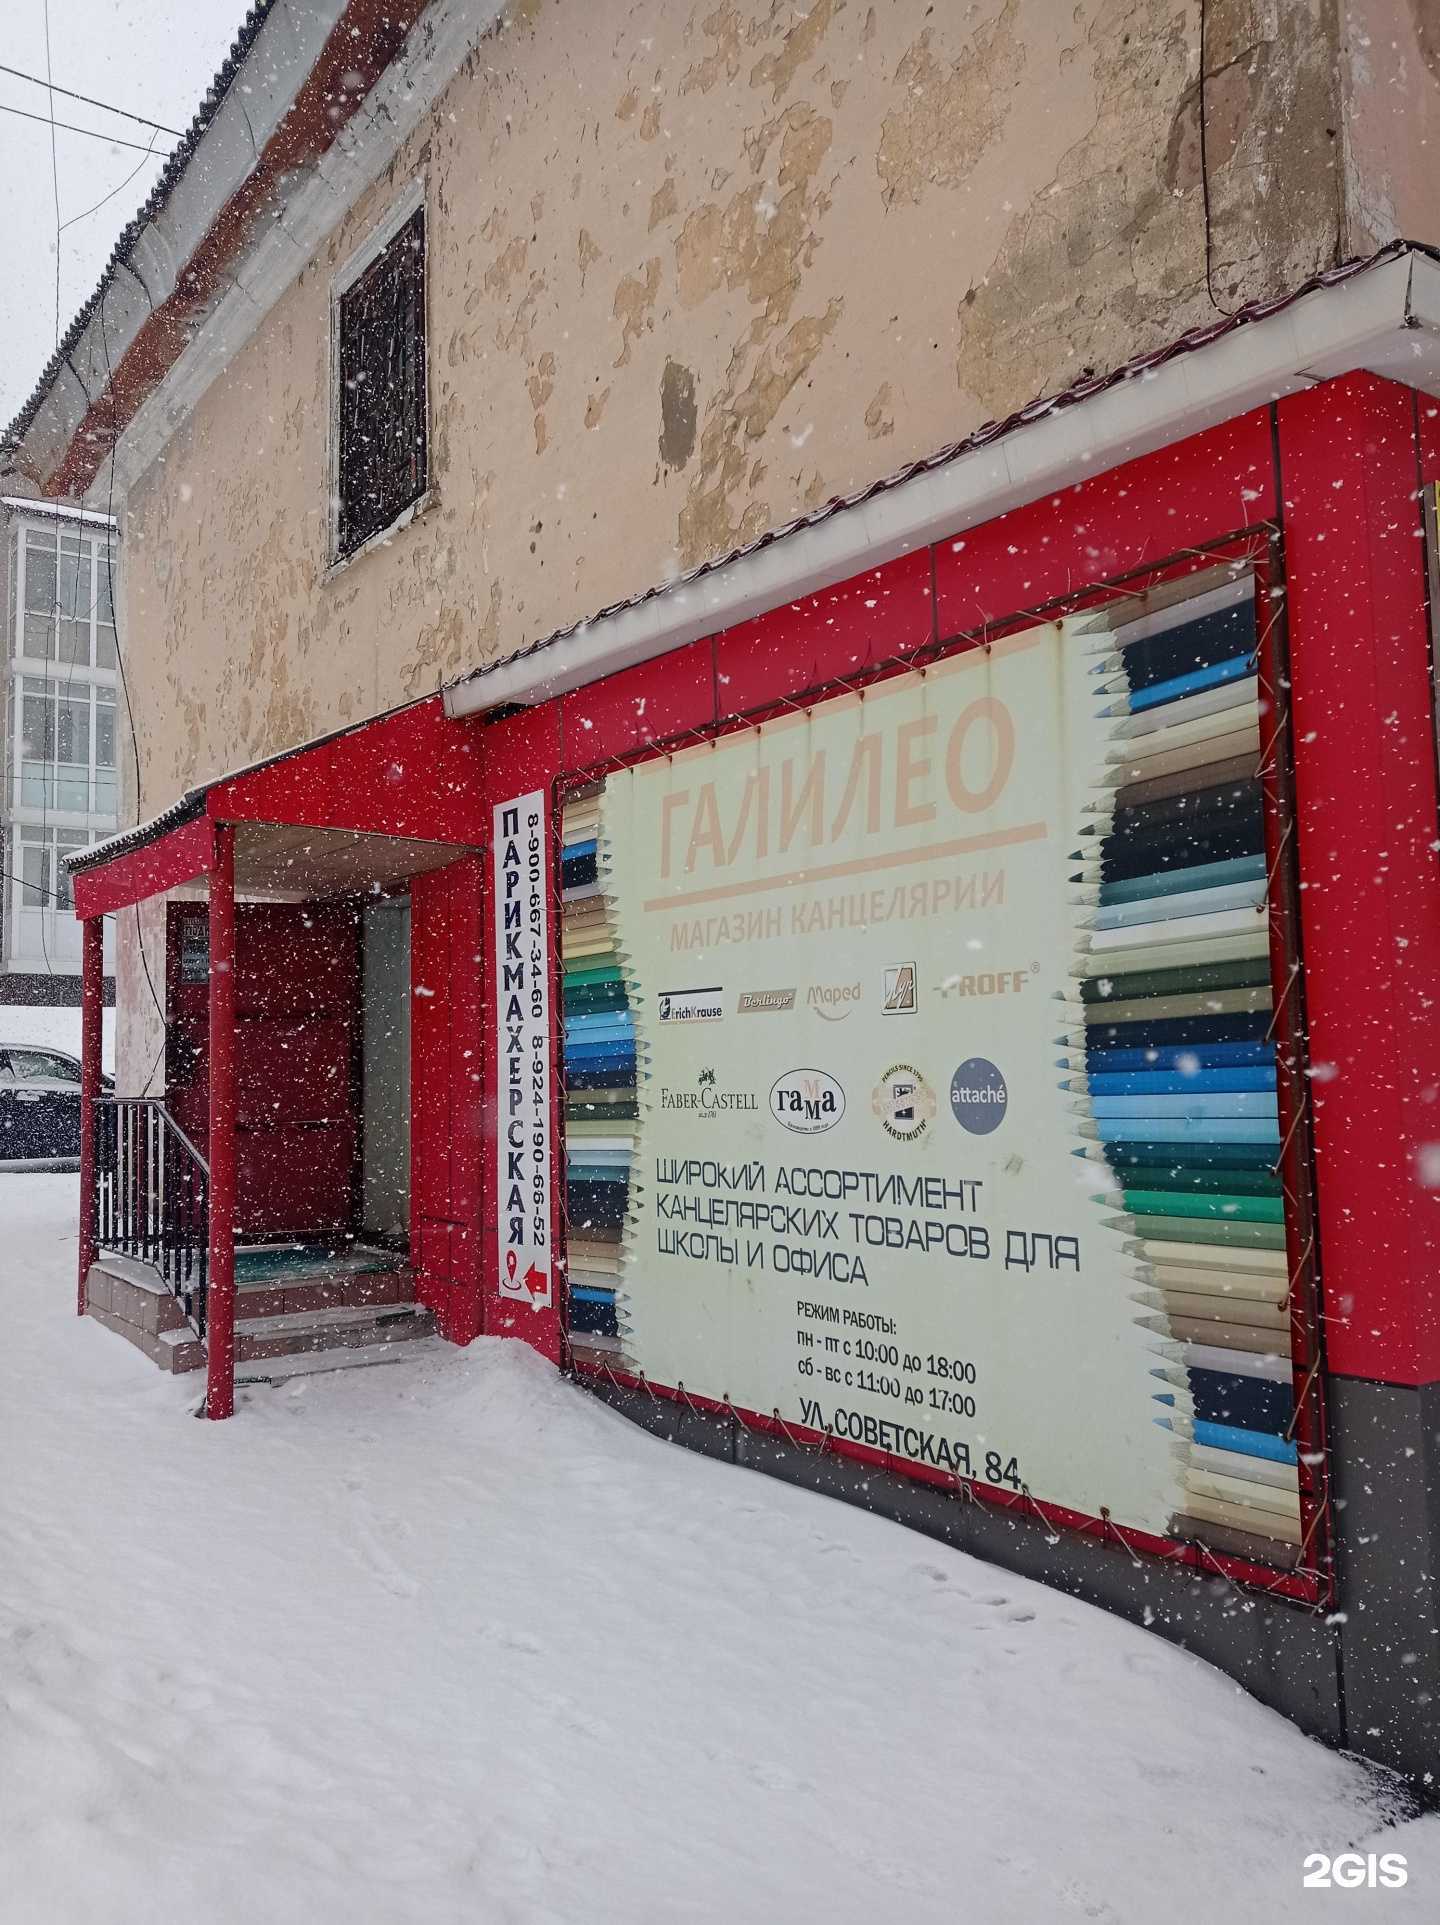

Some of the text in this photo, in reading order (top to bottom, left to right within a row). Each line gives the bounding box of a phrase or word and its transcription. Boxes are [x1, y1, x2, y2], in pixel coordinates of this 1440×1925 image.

[660, 697, 1015, 880] ГАЛИЛЕО
[670, 869, 1006, 952] МАГАЗИН КАНЦЕЛЯРИИ
[671, 1005, 723, 1020] ErichKrause
[807, 982, 861, 1006] Maped
[502, 807, 526, 1246] ПАРИКМАХЕРСКАЯ
[527, 813, 546, 1247] 8-900-667-34-60 8-924-190-66-52
[952, 1085, 1006, 1103] attaché
[656, 1158, 983, 1213] ШИРОКИЙ АССОРТИМЕНТ
[656, 1193, 1080, 1272] КАНЦЕЛЯРСКИХ ТОВАРОВ ДЛЯ
[657, 1228, 868, 1287] ШКОЛЫ И ОФИСА
[797, 1300, 897, 1336] РЕЖИМ РАБОТЫ:
[797, 1356, 813, 1376] сб
[825, 1366, 841, 1384] вс
[856, 1370, 900, 1399] 11:00
[905, 1385, 923, 1406] до
[928, 1387, 976, 1418] 17:00
[855, 1338, 899, 1367] 10:00
[902, 1352, 921, 1373] до
[926, 1353, 976, 1385] 18:00
[834, 1408, 977, 1480] СОВЕТСКАЯ,
[984, 1450, 1022, 1490] 84
